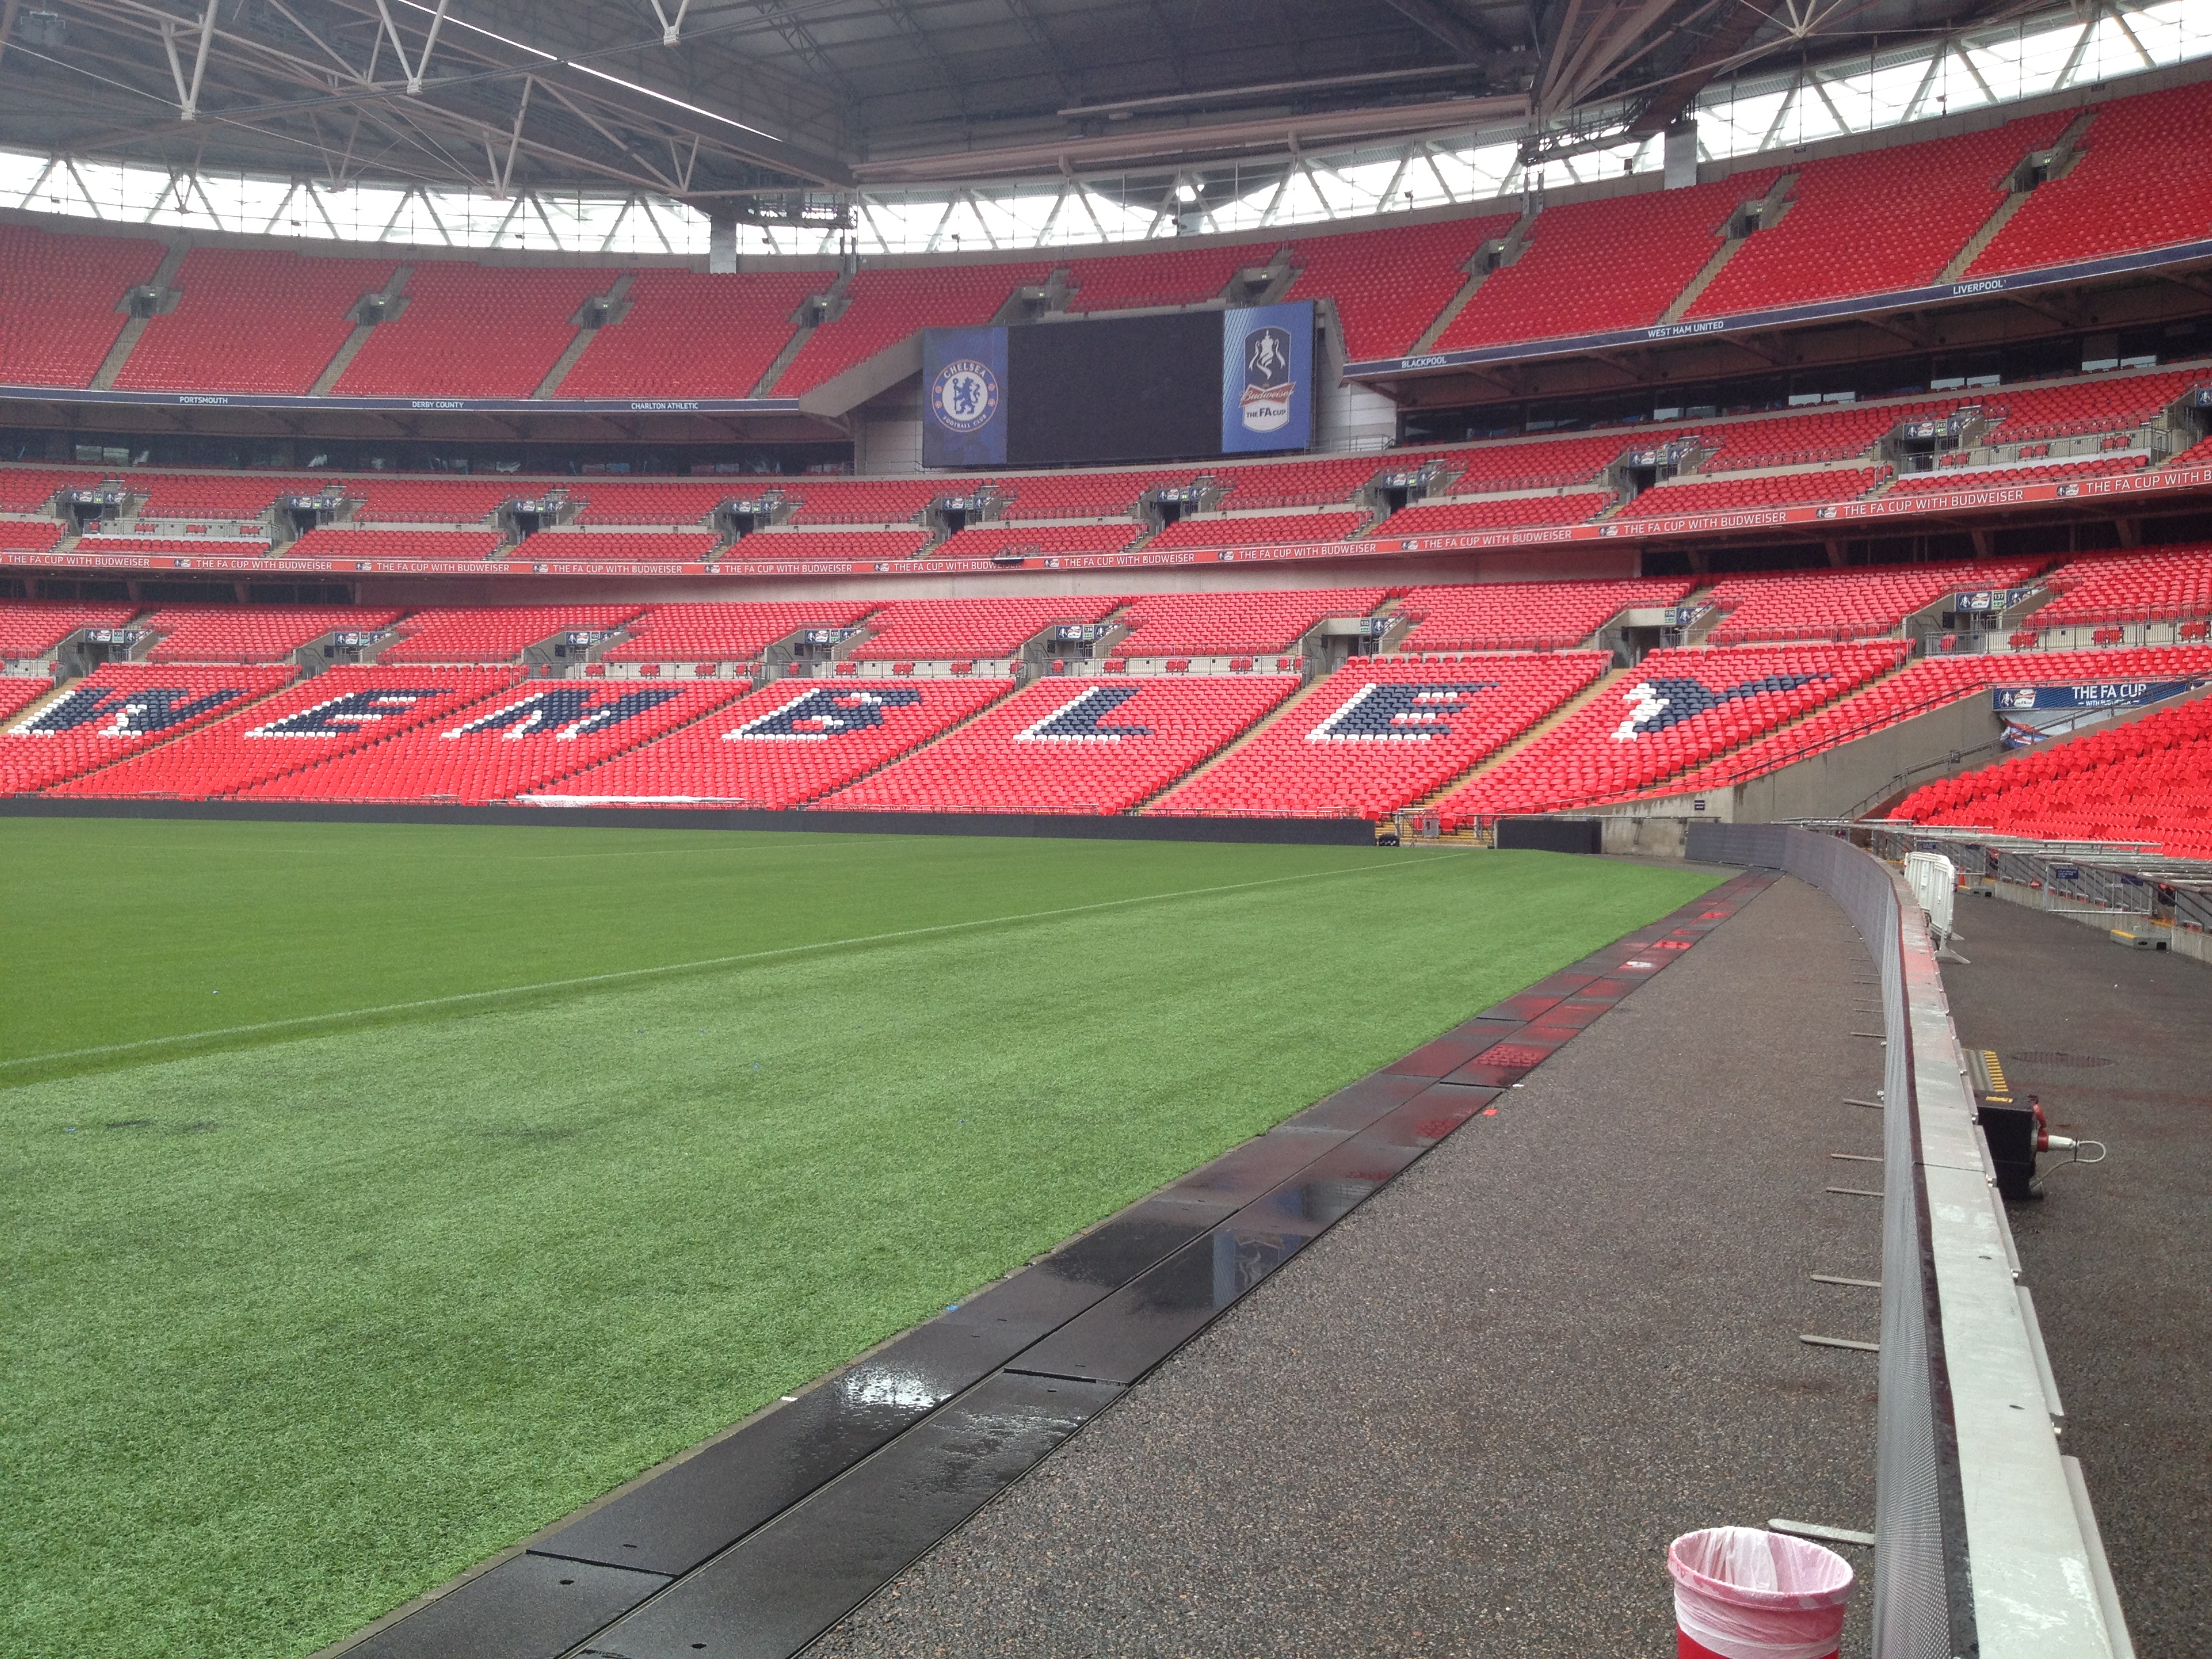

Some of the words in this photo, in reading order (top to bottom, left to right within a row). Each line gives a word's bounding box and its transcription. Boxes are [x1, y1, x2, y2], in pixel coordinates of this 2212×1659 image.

[1648, 327, 1671, 338] WEST
[1673, 325, 1692, 335] HAM
[1694, 321, 1724, 332] UNITED
[1401, 356, 1447, 368] BLACKPOOL
[943, 363, 986, 378] CHELSEA
[180, 396, 228, 404] PORTSMOUTH
[1259, 408, 1272, 417] FA
[943, 415, 971, 428] FOOTBALL
[2087, 480, 2110, 493] THE
[2116, 478, 2130, 490] FA
[2135, 476, 2160, 488] CUP
[2165, 472, 2198, 485] WITH
[1844, 504, 1866, 516] THE
[1871, 502, 1884, 513] FA
[1889, 500, 1911, 512] CUP
[1916, 497, 1946, 509] WITH
[1952, 490, 2022, 506] BUDWEISER
[1624, 524, 1644, 534] THE
[1648, 523, 1660, 532] FA
[1664, 520, 1685, 531] CUP
[1689, 518, 1717, 529] WITH
[1721, 512, 1786, 527] BUDWEISER
[1424, 539, 1441, 548] THE
[1446, 537, 1456, 547] FA
[1460, 536, 1479, 546] CUP
[1483, 534, 1509, 544] WITH
[1513, 530, 1571, 542] BUDWEISER
[1240, 550, 1256, 559] THE
[1260, 550, 1270, 558] FA
[1274, 548, 1291, 557] CUP
[1294, 547, 1318, 556] WITH
[1322, 544, 1375, 555] BUDWEISER
[8, 555, 26, 563] THE
[30, 556, 41, 564] FA
[45, 556, 63, 565] CUP
[96, 558, 149, 566] BUDWEISER
[197, 560, 213, 568] THE
[232, 560, 249, 569] CUP
[252, 561, 275, 569] WITH
[279, 562, 331, 570] BUDWEISER
[895, 563, 910, 571] THE
[927, 562, 943, 571] CUP
[946, 562, 968, 570] WITH
[1065, 558, 1080, 567] THE
[1084, 558, 1094, 566] FA
[1097, 556, 1113, 565] CUP
[1117, 556, 1139, 565] WITH
[1143, 554, 1193, 564] BUDWEISER
[758, 565, 774, 573] CUP
[777, 565, 800, 573] WITH
[2072, 685, 2097, 699] THE
[2100, 684, 2117, 698] FA
[2120, 683, 2146, 697] CUP
